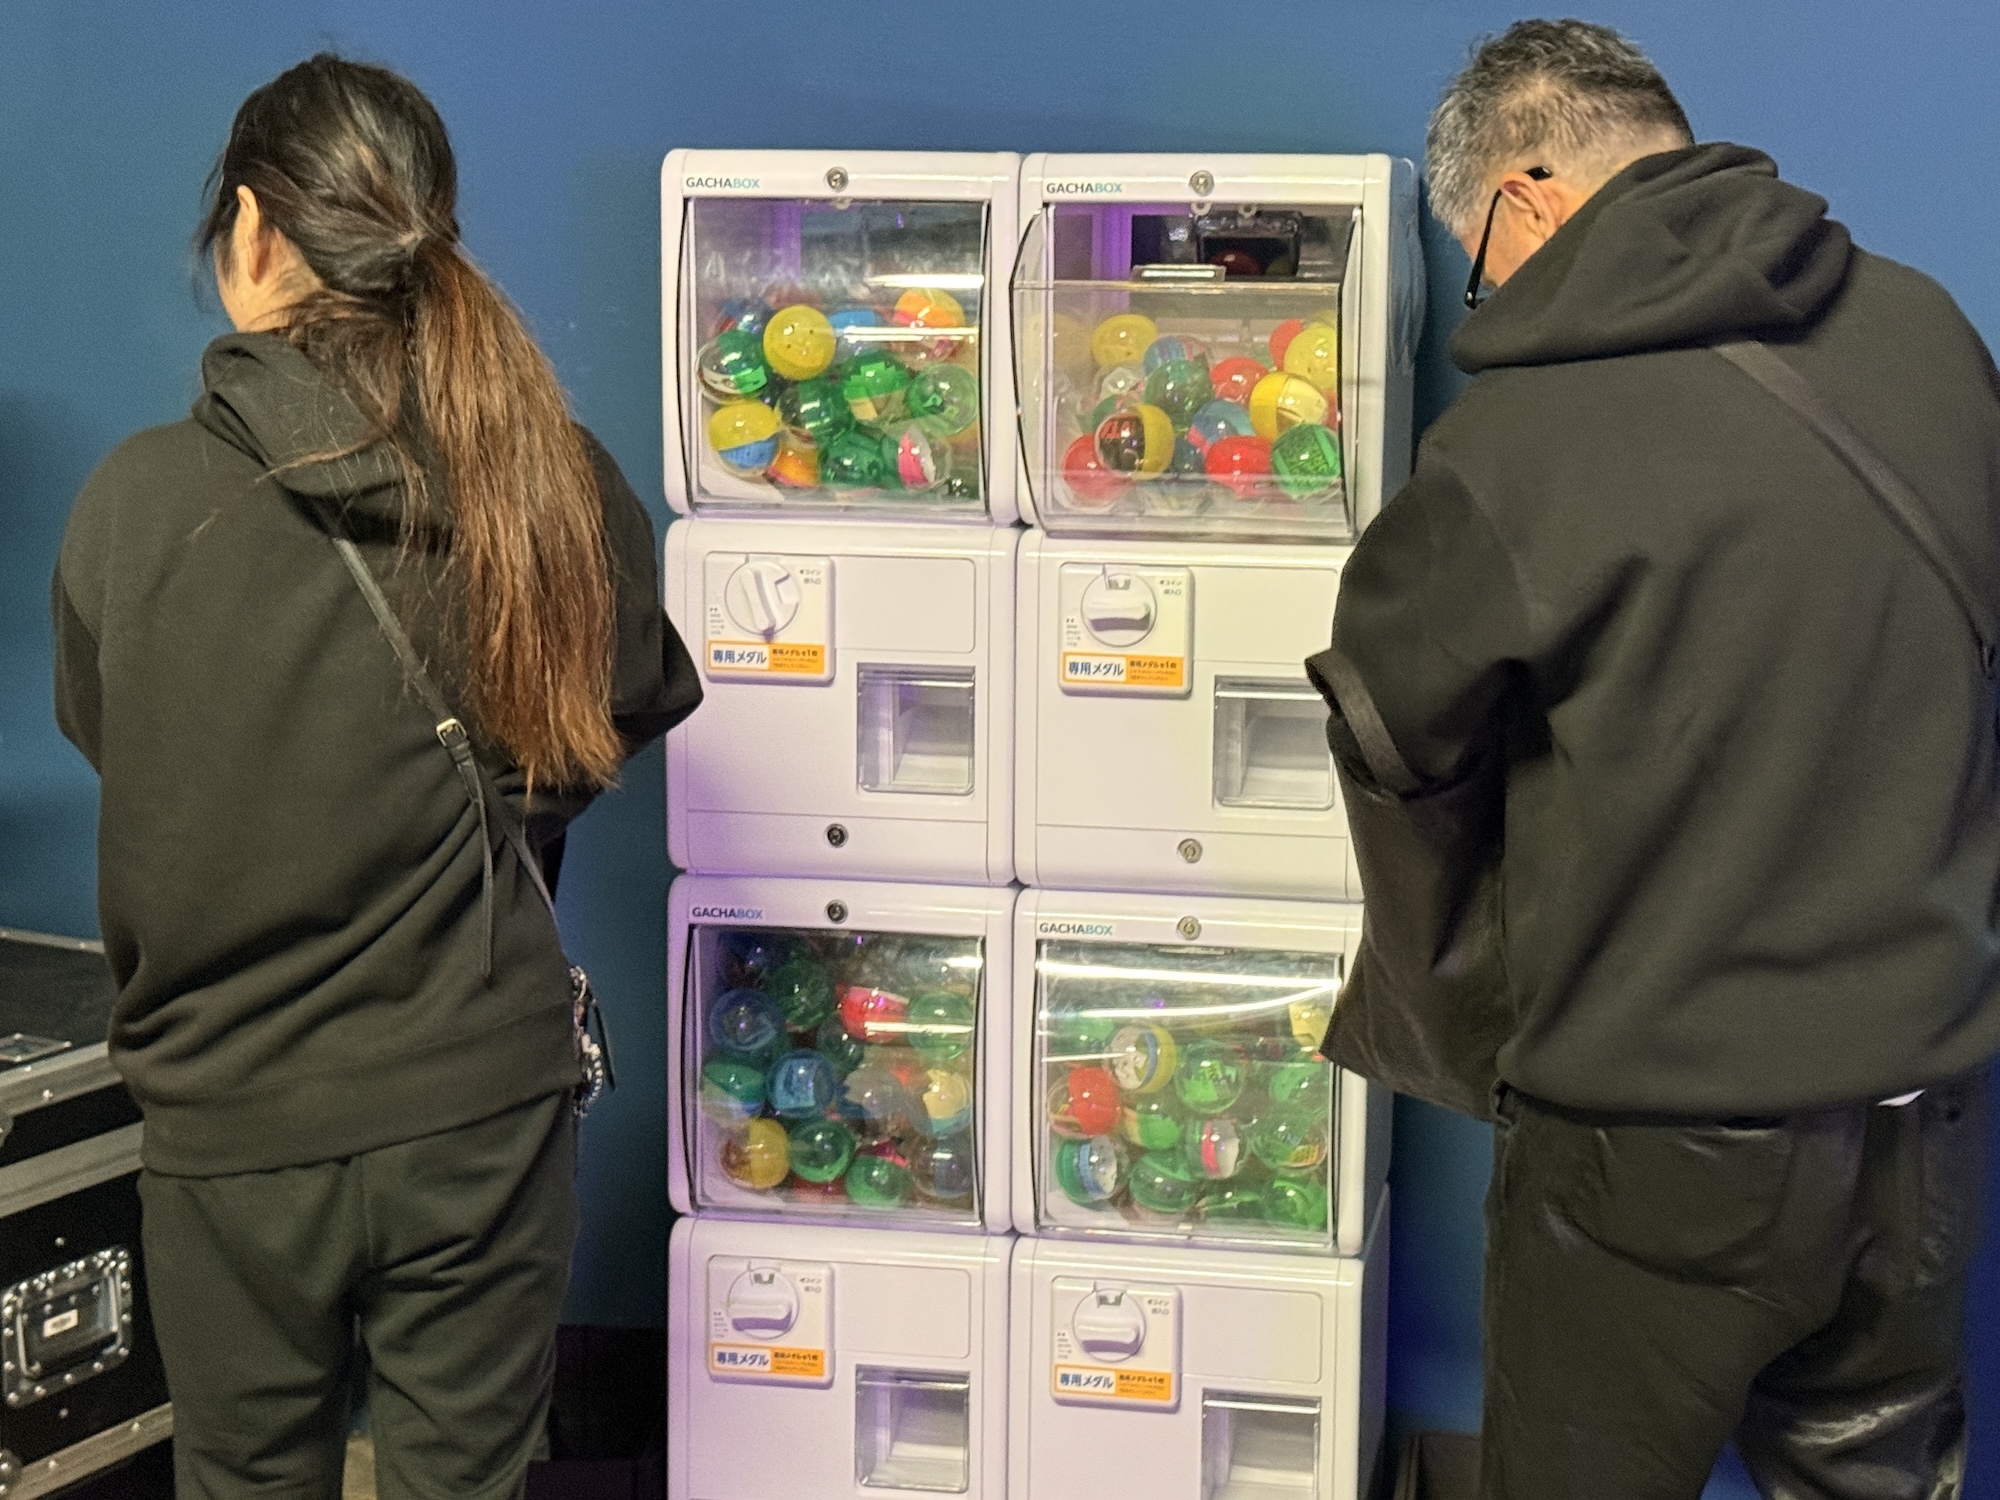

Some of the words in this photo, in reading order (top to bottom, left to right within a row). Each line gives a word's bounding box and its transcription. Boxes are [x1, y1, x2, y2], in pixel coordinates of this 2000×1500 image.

[685, 177, 760, 189] GACHABOX
[1046, 182, 1123, 194] GACHABOX
[713, 649, 767, 664] 専用メダル
[1068, 661, 1124, 676] 専用メダル
[692, 907, 763, 919] GACHABOX
[1039, 922, 1112, 935] GACHABOX
[717, 1351, 769, 1366] 専用メダル
[1060, 1373, 1114, 1389] 専用メダル
